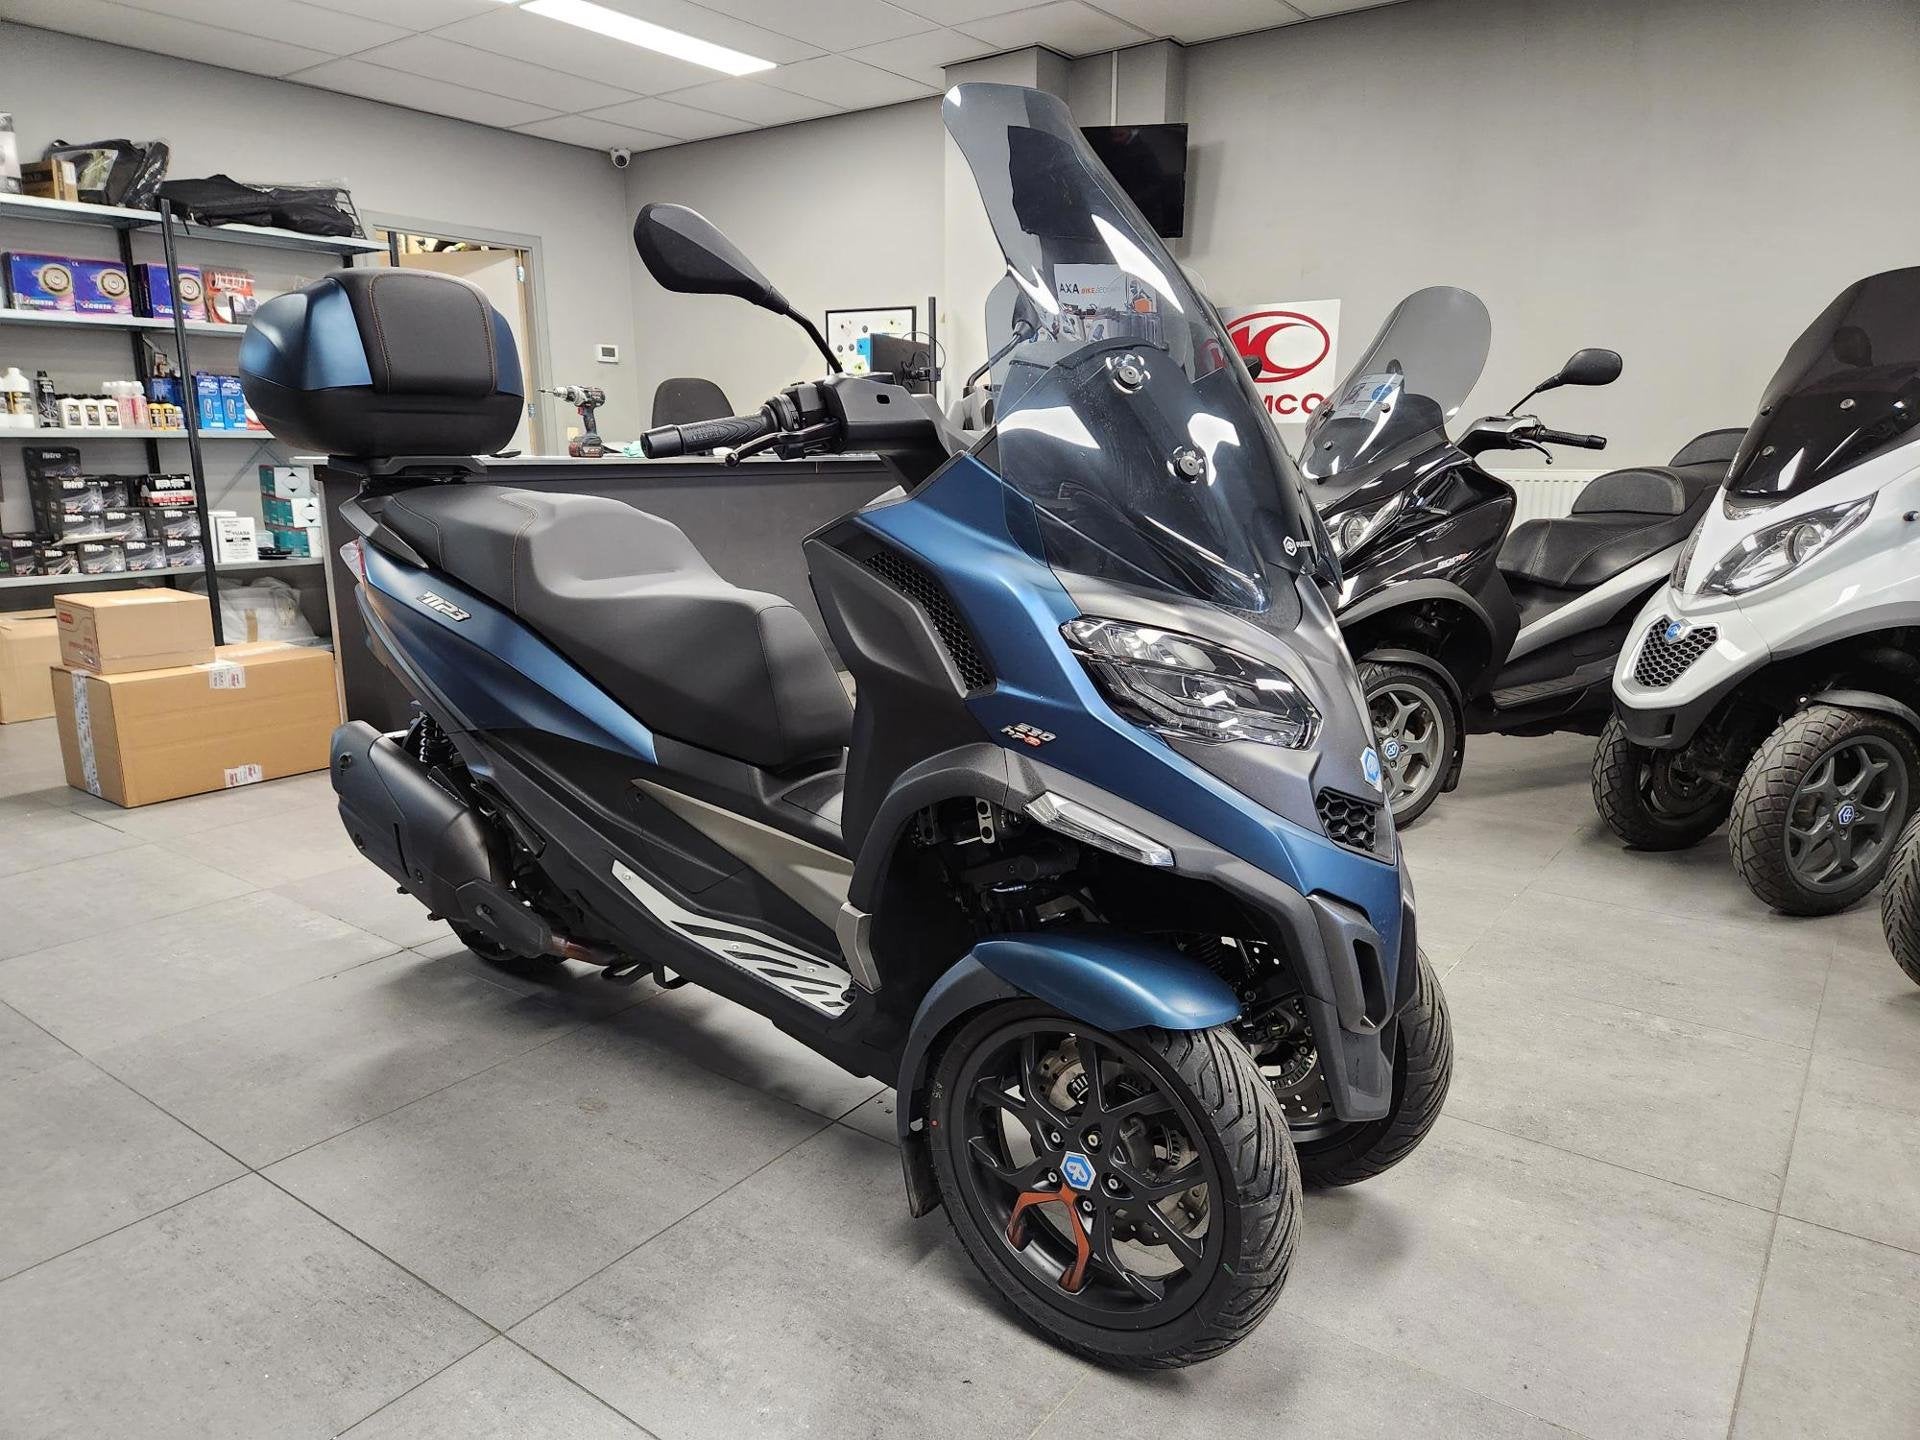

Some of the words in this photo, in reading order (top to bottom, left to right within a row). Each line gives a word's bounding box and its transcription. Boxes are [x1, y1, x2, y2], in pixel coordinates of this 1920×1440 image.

[1060, 283, 1080, 294] AXA
[63, 480, 84, 489] nitro
[64, 514, 84, 522] nitro
[84, 544, 104, 552] nitro
